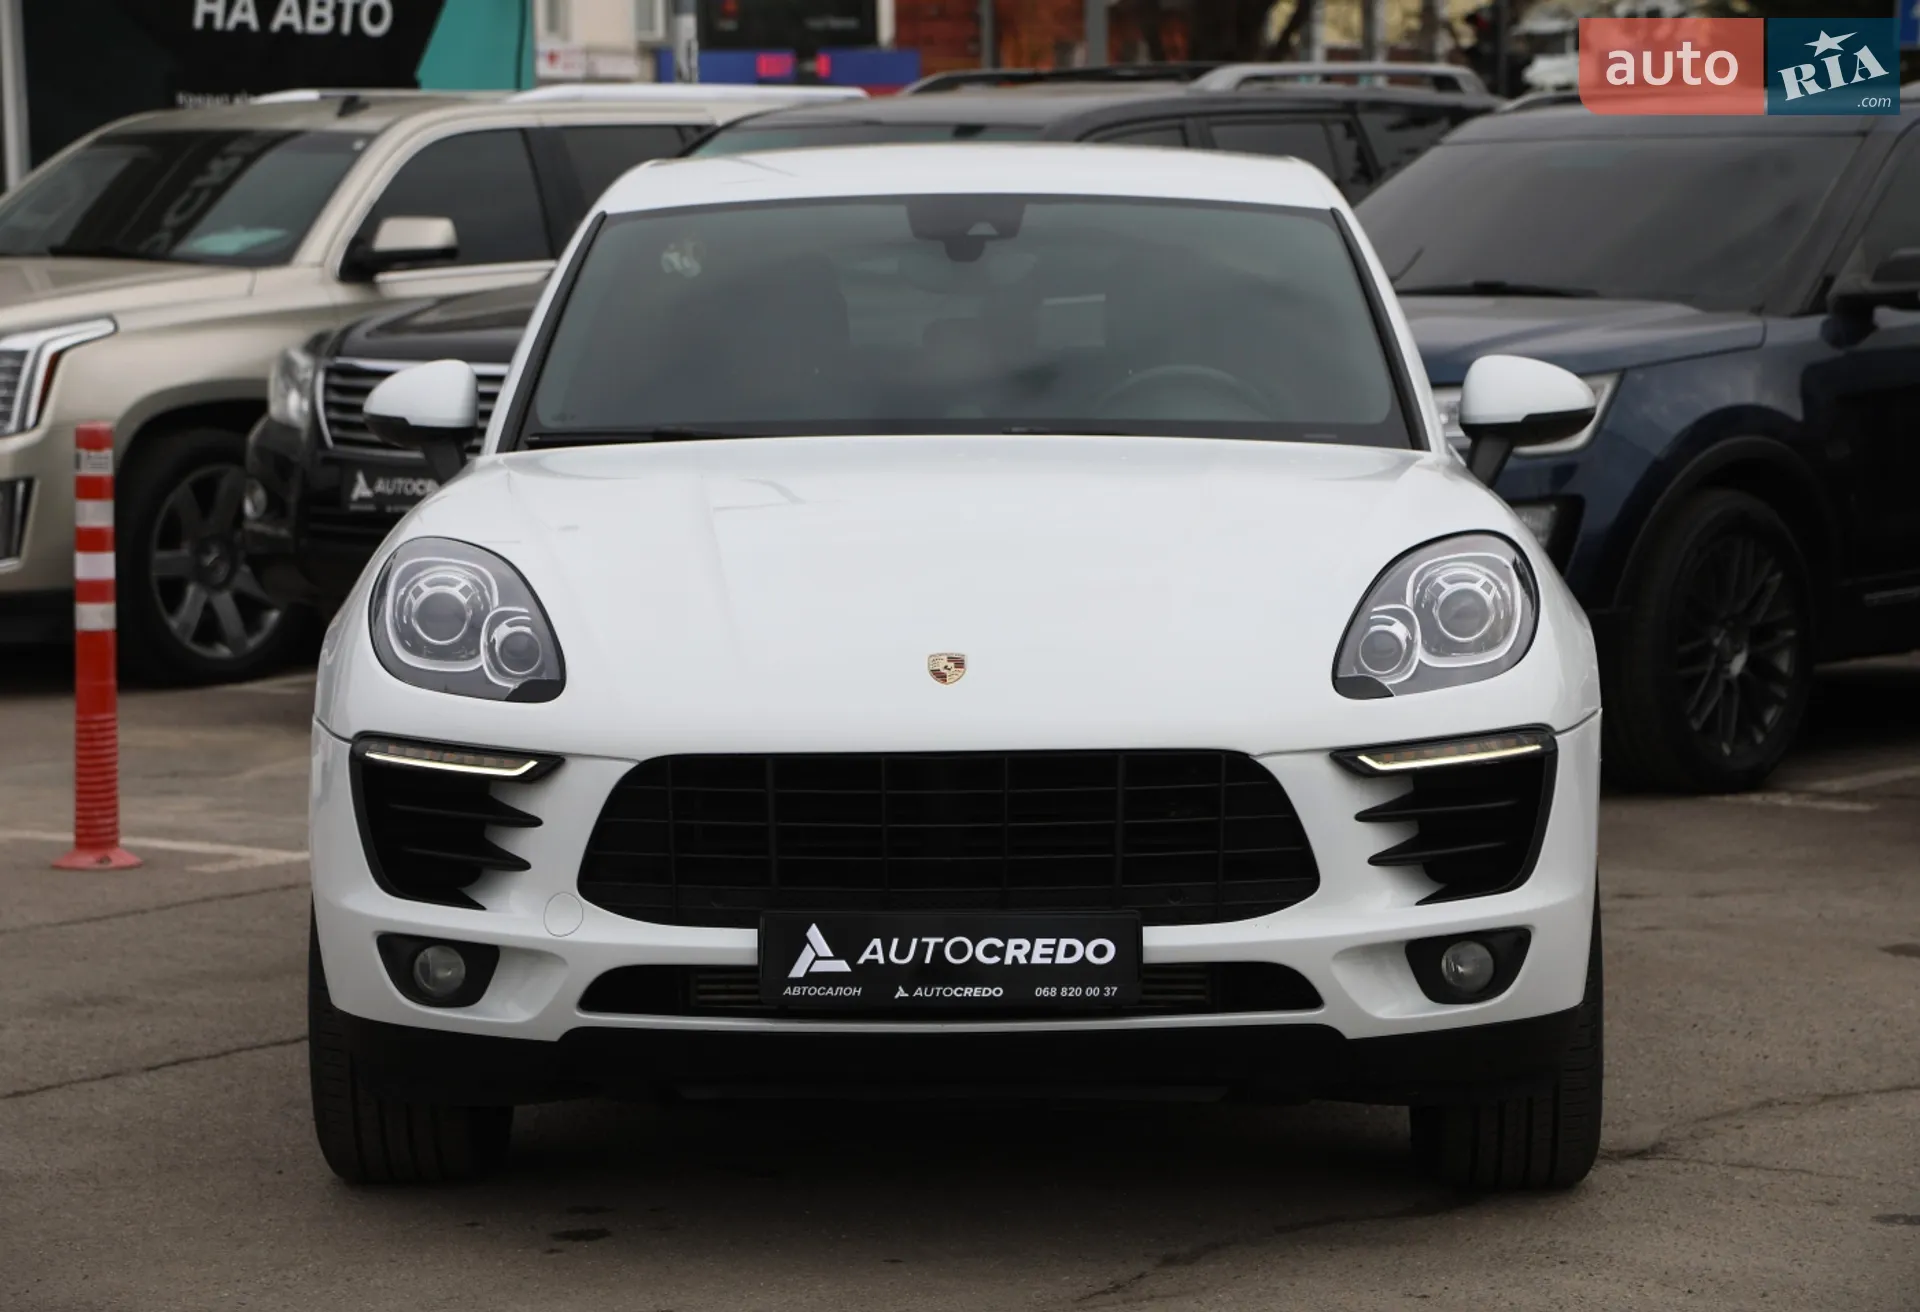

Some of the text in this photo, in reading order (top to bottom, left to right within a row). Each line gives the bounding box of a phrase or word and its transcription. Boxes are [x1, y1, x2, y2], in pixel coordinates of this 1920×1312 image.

[193, 0, 393, 37] НА АВТО
[856, 936, 1116, 965] AUTOCREDO
[783, 986, 862, 997] АВТОСАЛОН
[912, 986, 1004, 998] AUTOCREDO
[1035, 986, 1118, 998] 068 820 00 37
